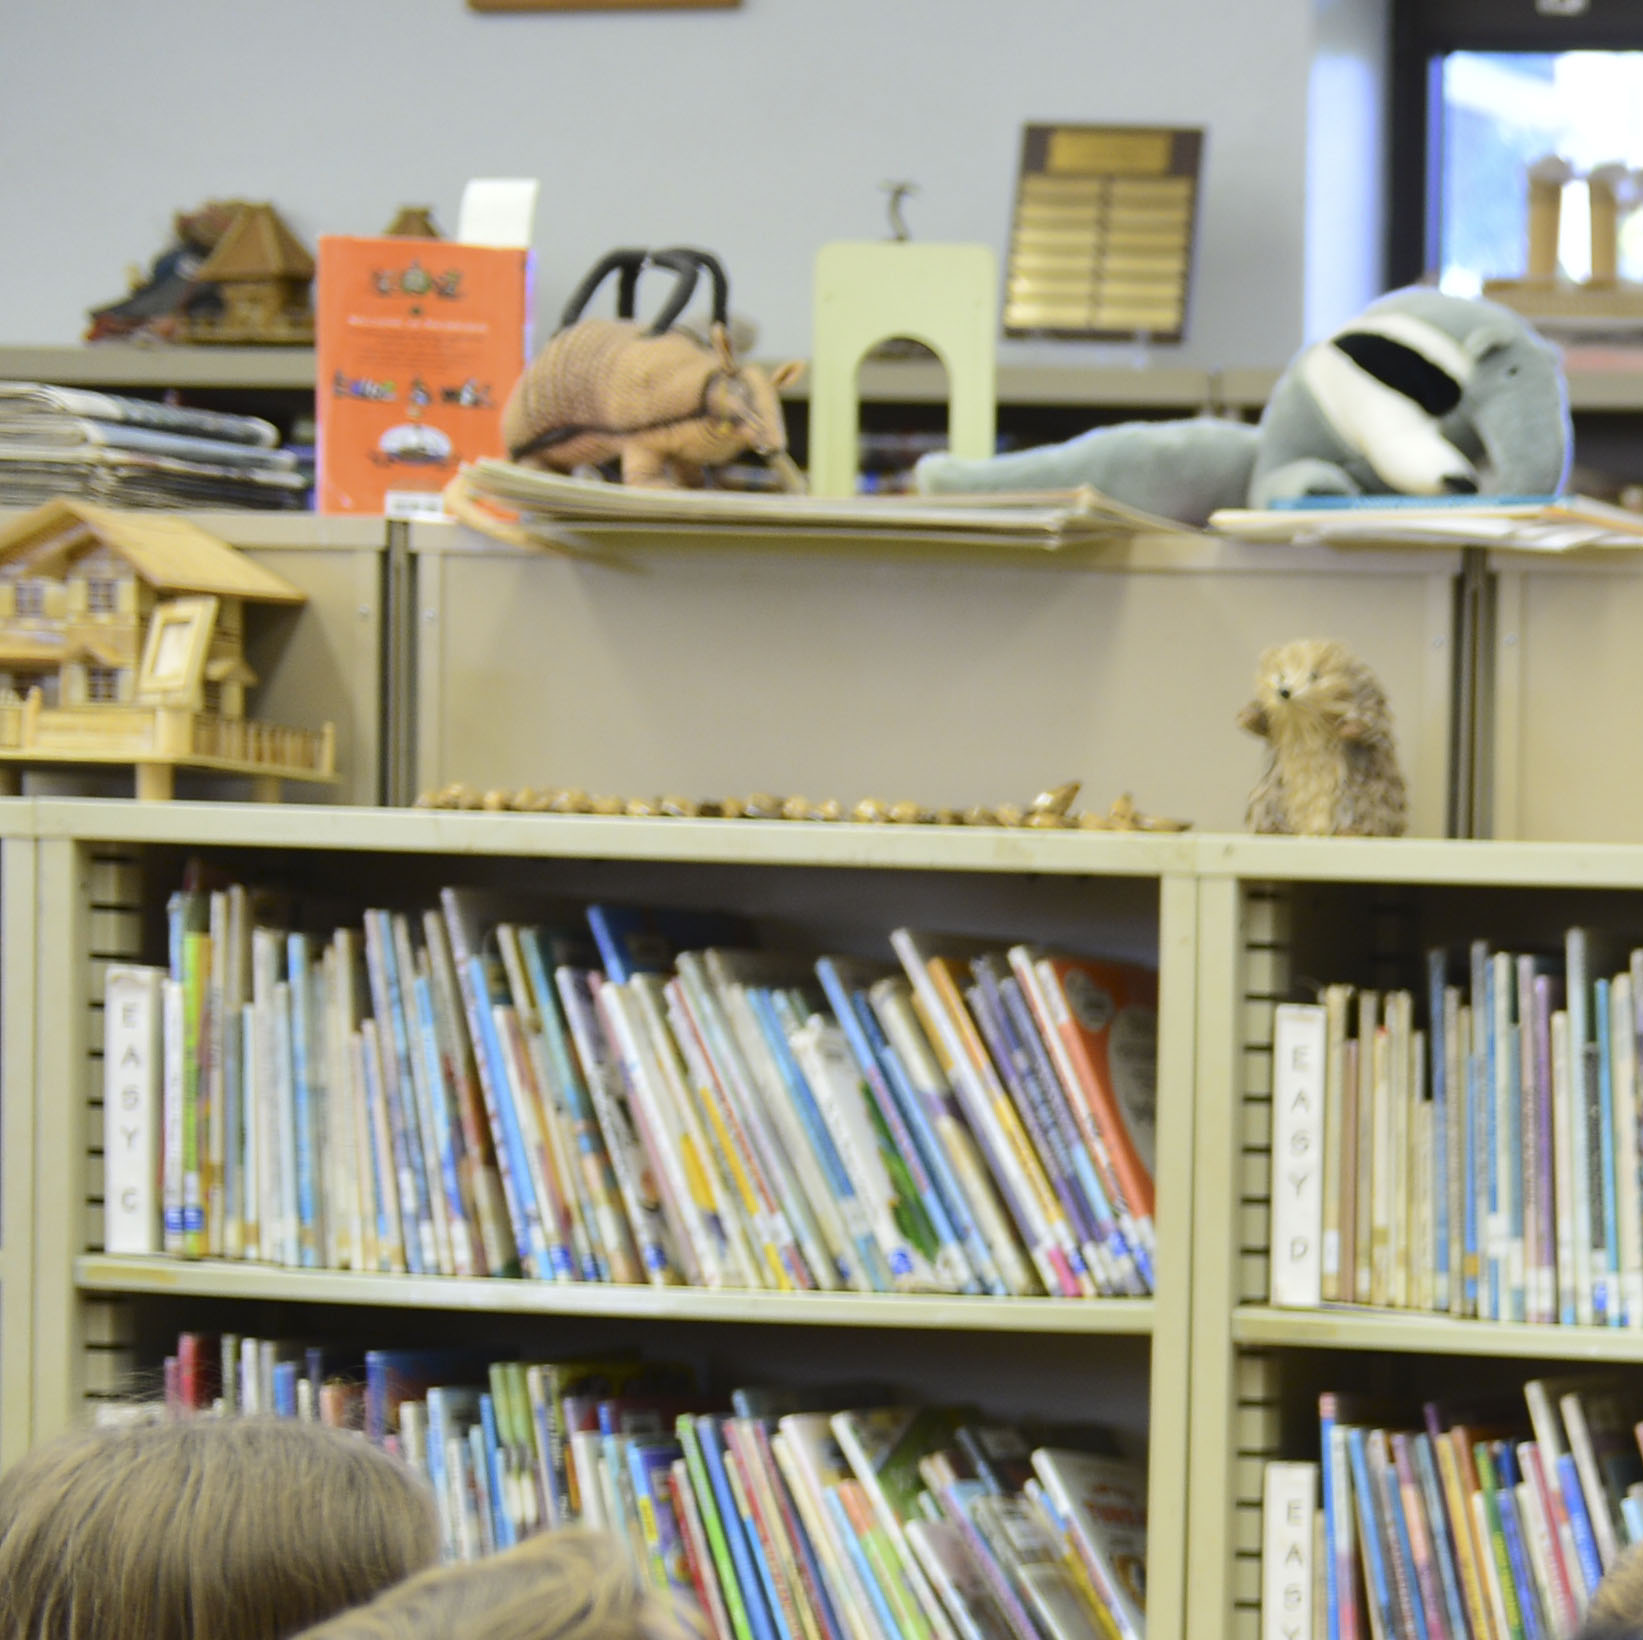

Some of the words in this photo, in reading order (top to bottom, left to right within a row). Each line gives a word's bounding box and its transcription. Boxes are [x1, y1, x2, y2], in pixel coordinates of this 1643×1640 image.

[120, 1003, 141, 1148] EASY
[1289, 1045, 1310, 1197] EASY
[121, 1187, 138, 1214] C
[1290, 1236, 1309, 1263] D
